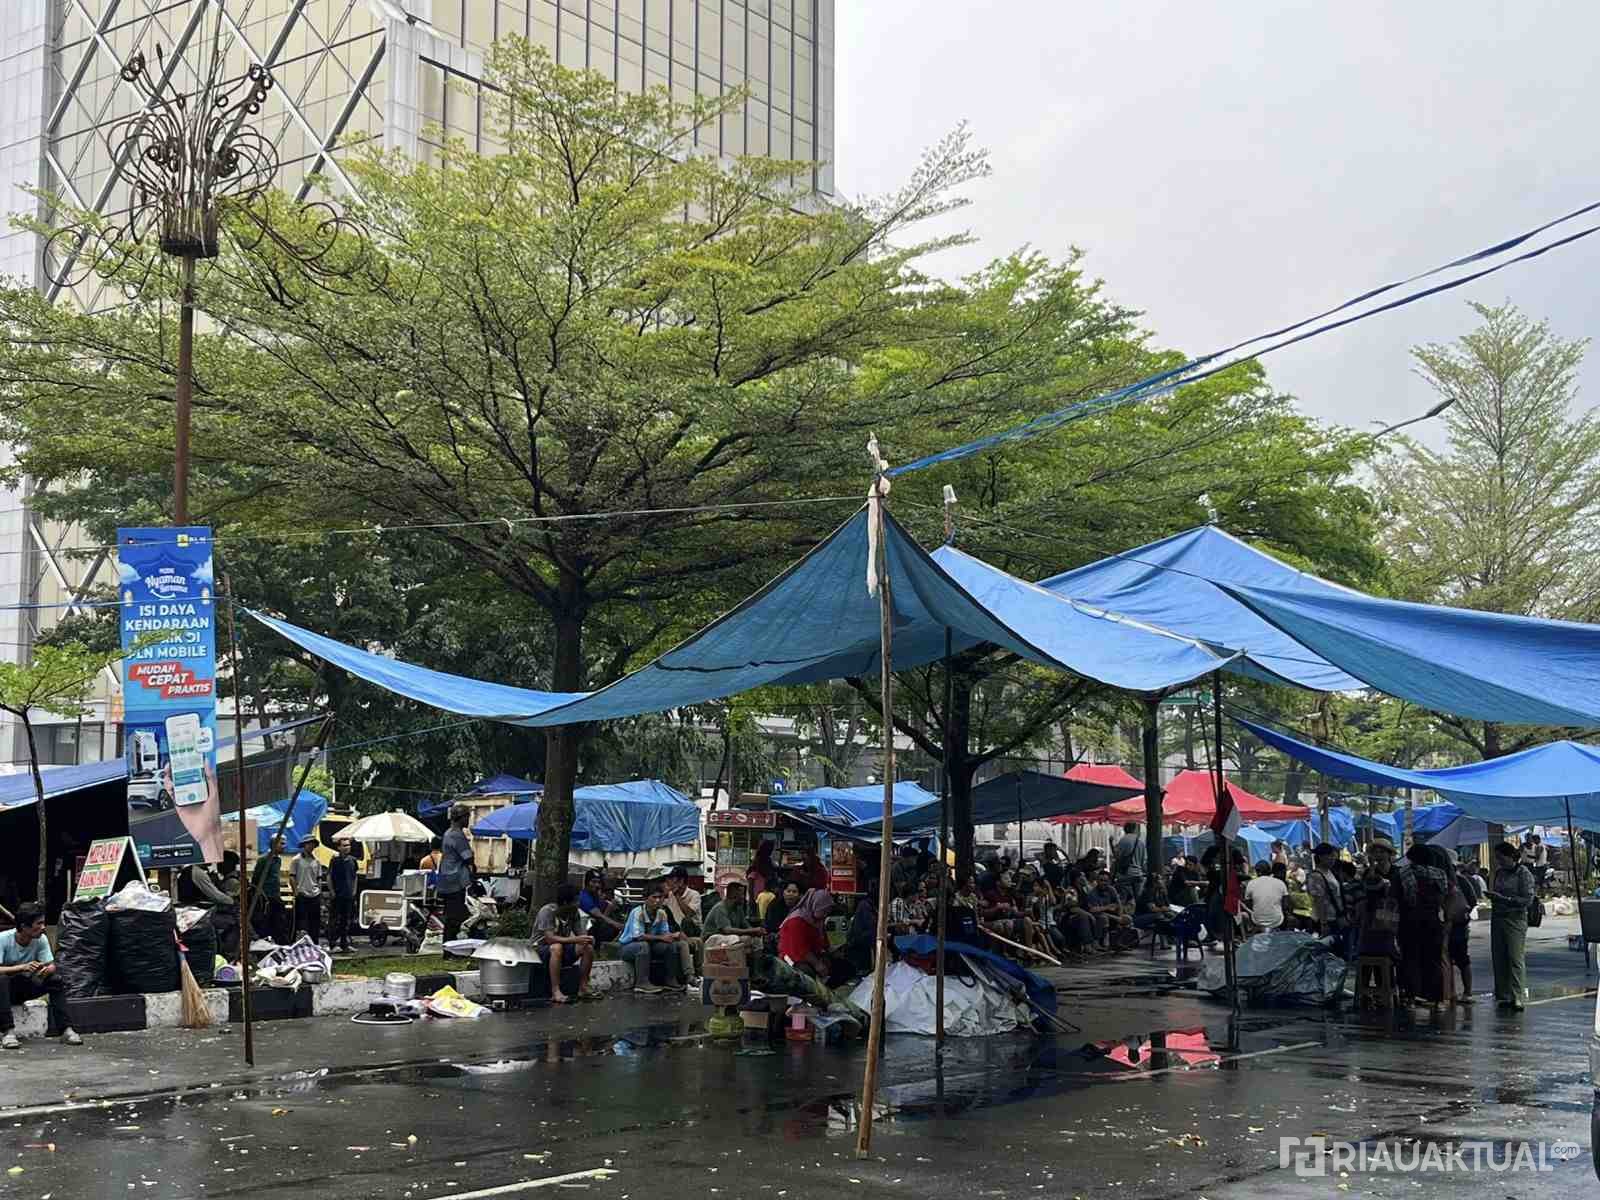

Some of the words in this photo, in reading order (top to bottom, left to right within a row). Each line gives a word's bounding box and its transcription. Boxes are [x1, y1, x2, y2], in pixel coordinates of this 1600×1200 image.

[145, 575, 186, 589] Nyaman
[139, 605, 156, 617] ISI
[159, 603, 196, 616] DAYA
[125, 617, 209, 631] KENDARAAN
[158, 645, 207, 658] MOBILE
[136, 664, 176, 675] MUDAH
[148, 673, 189, 686] CEPAT
[167, 683, 210, 695] PRAKTIS
